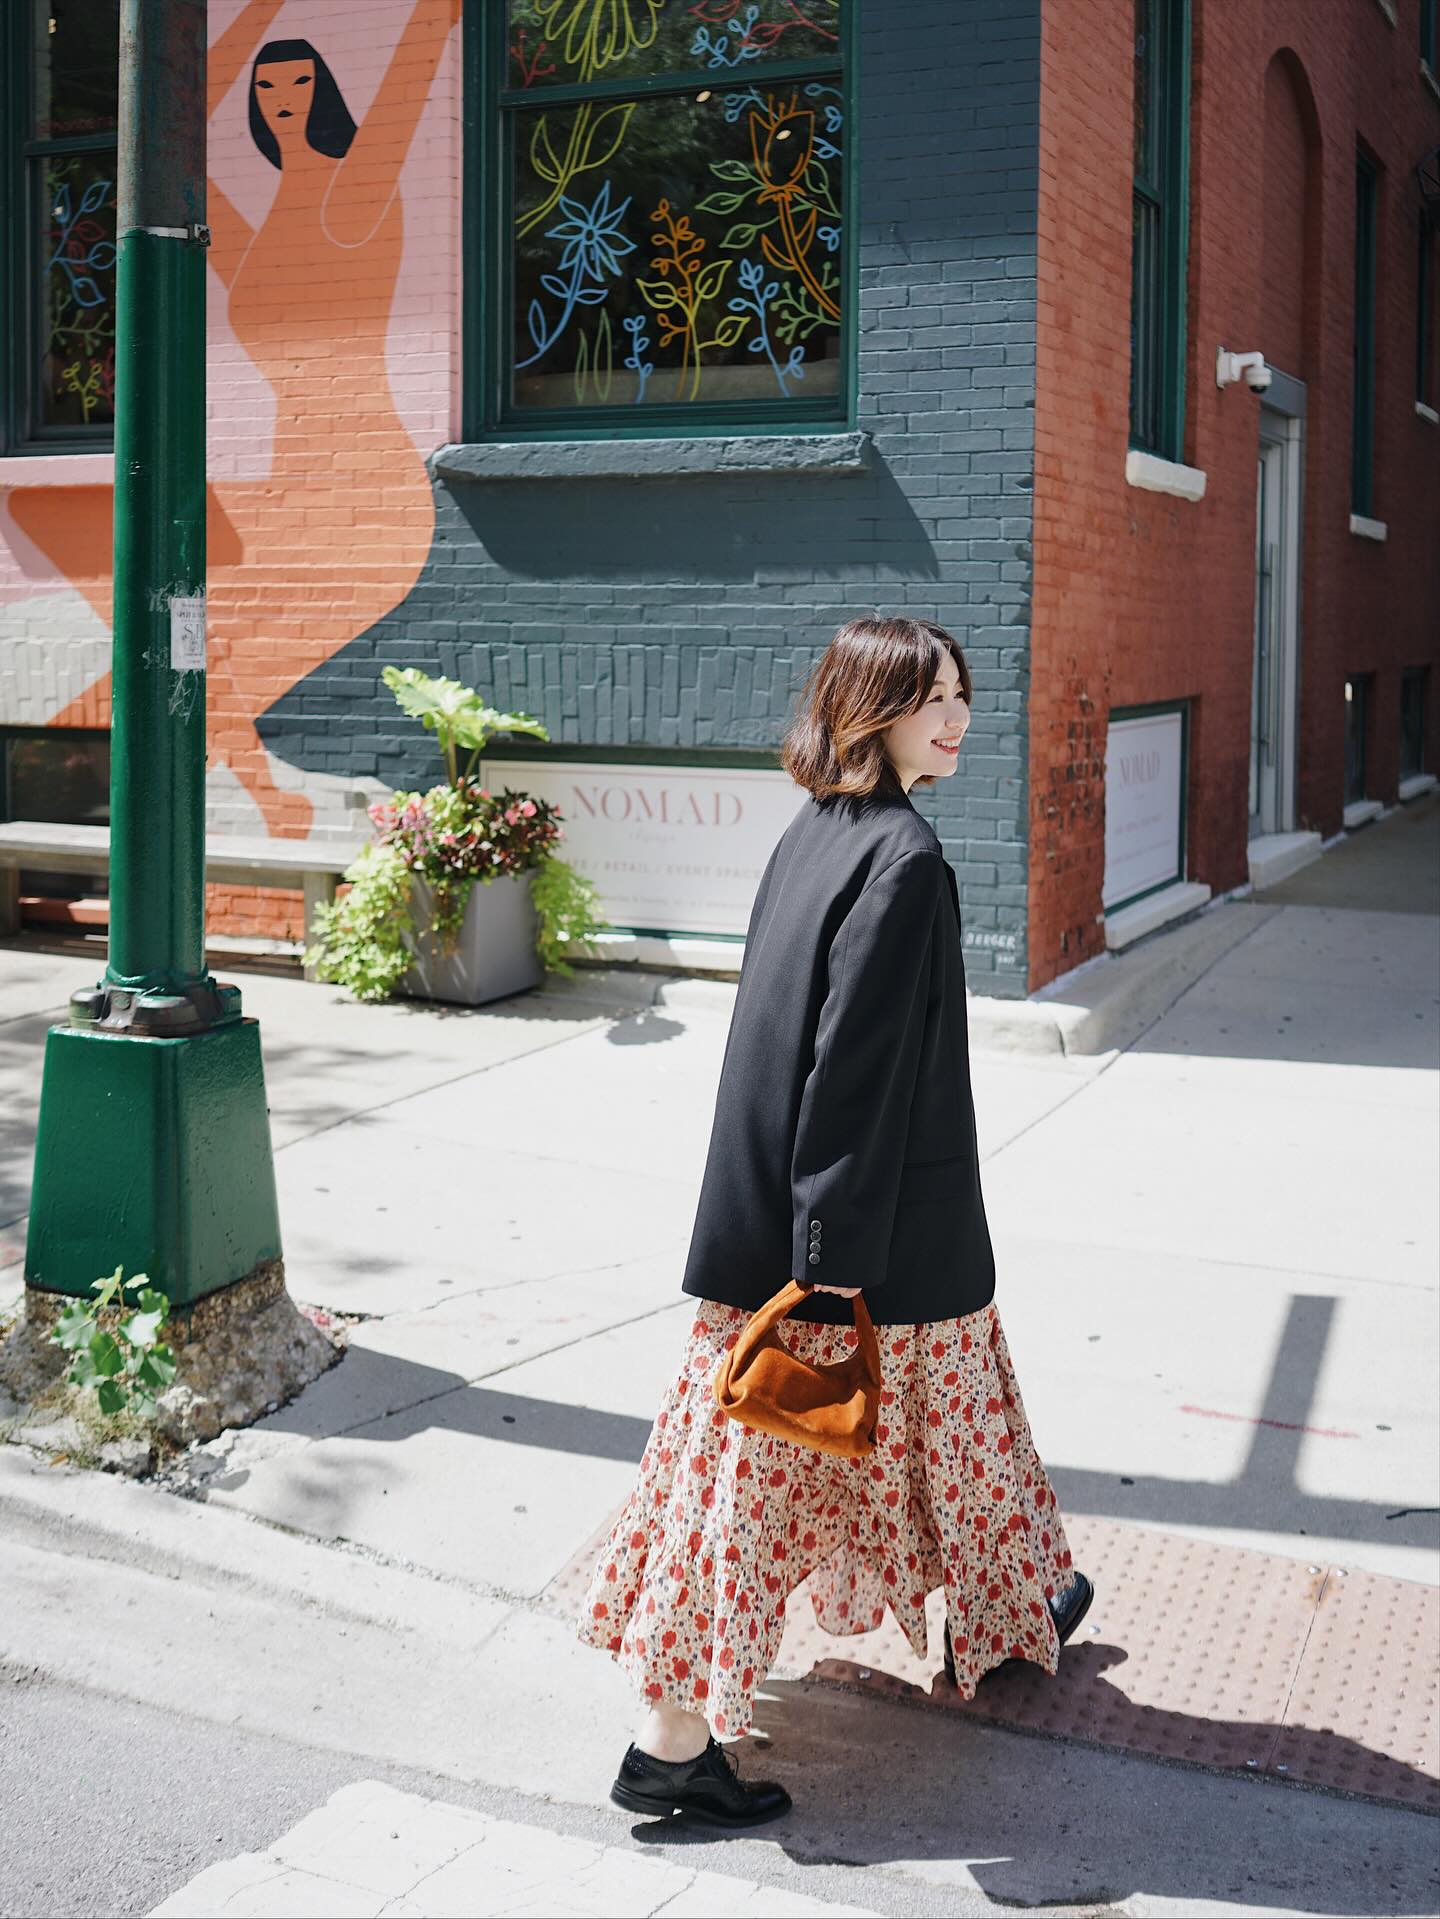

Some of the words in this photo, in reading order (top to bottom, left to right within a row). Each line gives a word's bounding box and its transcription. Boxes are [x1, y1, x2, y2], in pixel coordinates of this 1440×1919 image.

[1120, 752, 1161, 786] NOMAD
[572, 785, 744, 827] NOMAD
[604, 860, 649, 874] RETAIL
[667, 864, 711, 877] EVENT
